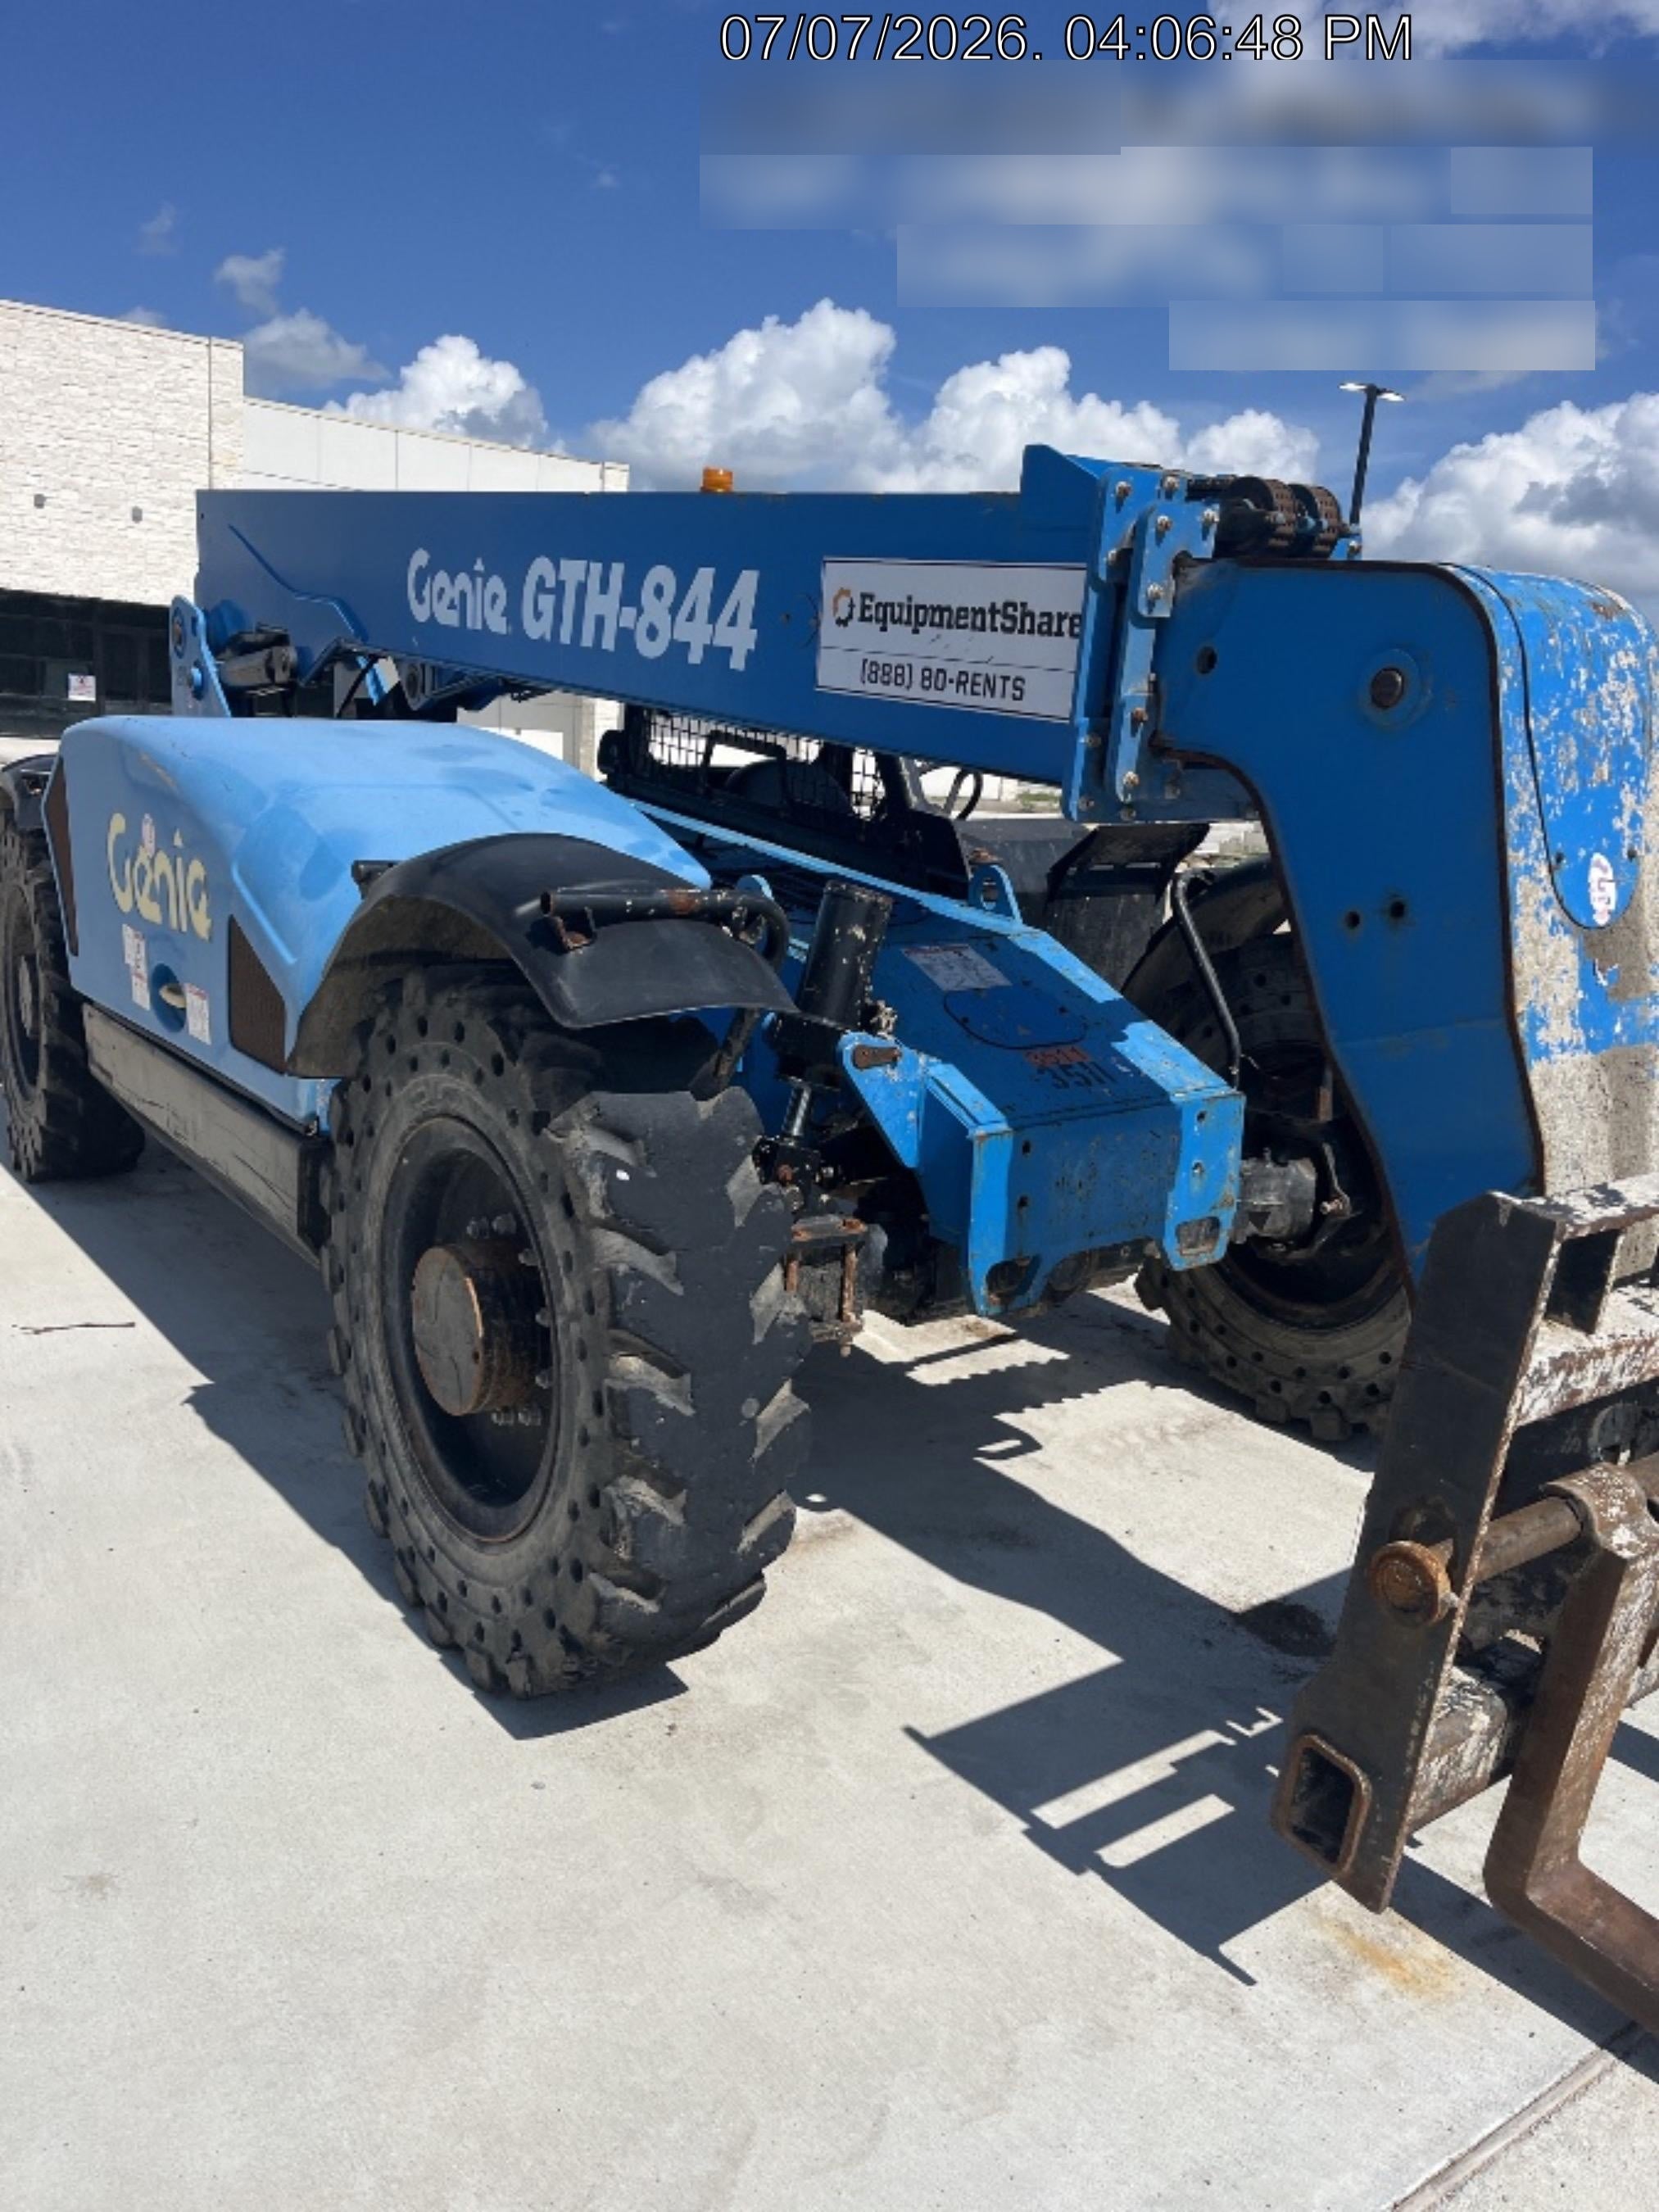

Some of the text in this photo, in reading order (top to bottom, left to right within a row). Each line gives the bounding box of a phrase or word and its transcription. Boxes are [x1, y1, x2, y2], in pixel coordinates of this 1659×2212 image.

[406, 547, 760, 671] Genie GTH-844
[859, 592, 1082, 639] EquipmentShare
[861, 658, 1026, 701] (888) 80-RENTS
